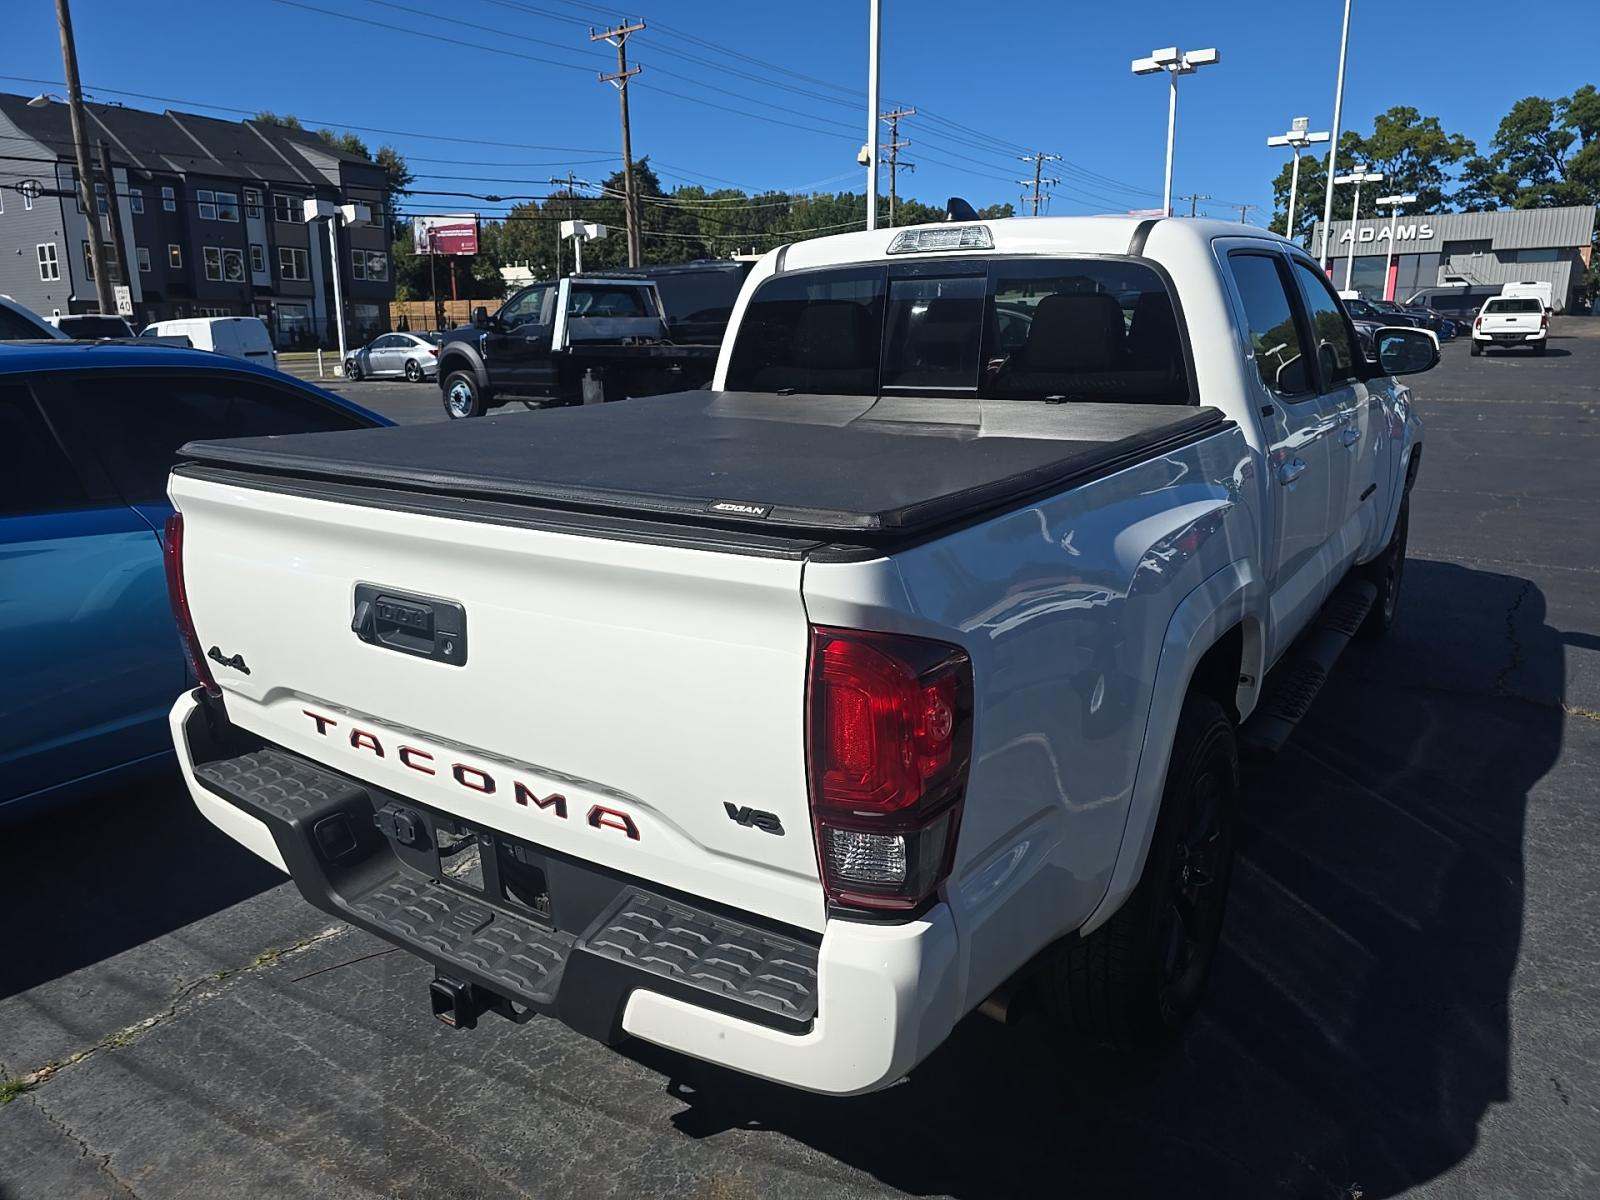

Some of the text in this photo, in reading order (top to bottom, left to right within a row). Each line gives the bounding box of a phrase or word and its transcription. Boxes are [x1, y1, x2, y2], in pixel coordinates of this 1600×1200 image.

[1340, 224, 1434, 243] ADAMS
[120, 301, 130, 311] 40
[303, 709, 641, 842] TACOMA
[723, 801, 786, 837] V6
